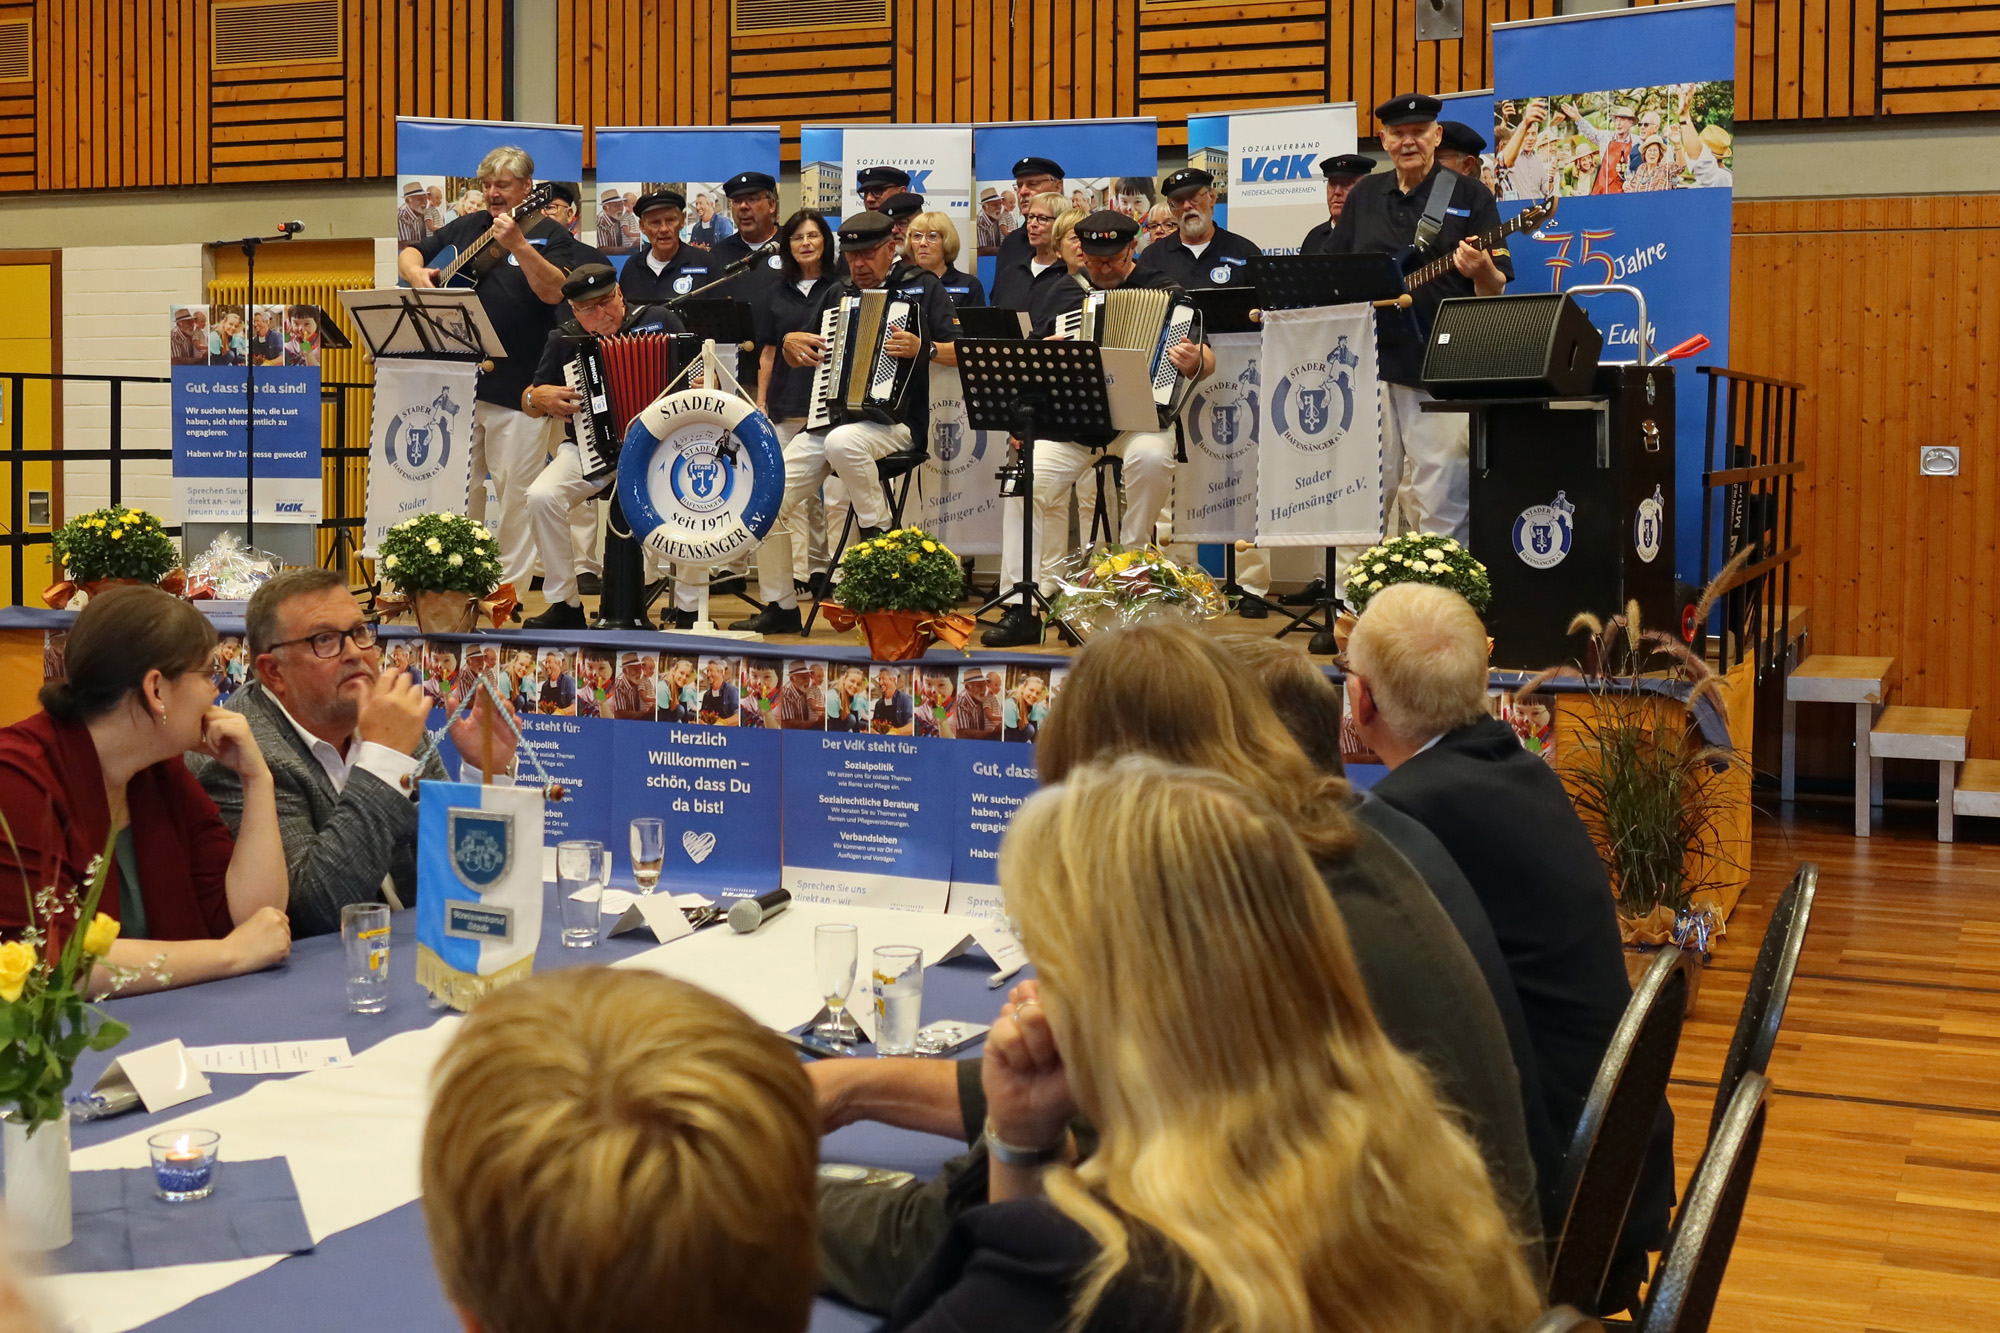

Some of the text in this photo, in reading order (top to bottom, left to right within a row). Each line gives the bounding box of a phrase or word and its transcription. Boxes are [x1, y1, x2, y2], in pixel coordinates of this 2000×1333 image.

[1242, 142, 1320, 152] SOZIALVERBAND
[1242, 154, 1318, 182] VdK
[1262, 248, 1302, 256] MEINS
[1532, 227, 1667, 297] 75 Jahre
[588, 356, 599, 384] HOHNER
[1290, 362, 1326, 379] STADER
[186, 382, 306, 394] Gut, dass Se da sind!
[1205, 382, 1238, 395] STADER
[228, 408, 268, 416] Menshen,
[402, 405, 431, 418] STADER
[661, 396, 726, 420] STADER
[929, 400, 961, 413] STADER
[1284, 431, 1335, 452] HAFENSÄNGER
[274, 451, 307, 459] geweckt?
[684, 445, 717, 457] STADER
[1199, 442, 1245, 460] HAFENSÄNGER
[393, 462, 432, 481] HAFENSÄNGER
[924, 462, 966, 476] AFENSÄNGER
[1208, 475, 1241, 493] Stader
[1295, 469, 1332, 490] Stader
[188, 487, 223, 496] Sprechen
[929, 490, 962, 508] Stader
[1271, 476, 1367, 521] Hafensänger e.V.
[276, 503, 303, 512] VdK
[399, 497, 427, 513] Stader
[681, 497, 723, 510] HAFENSÄNGER
[977, 499, 995, 514] e.V.
[1186, 492, 1252, 521] Hafensänger
[1525, 508, 1551, 517] STADER
[671, 511, 732, 531] seit 1977
[652, 512, 766, 559] HAFENSÄNGER e.V.
[535, 721, 560, 732] steht
[563, 721, 580, 733] für:
[670, 730, 727, 746] Herzlich
[822, 739, 918, 754] Der VdK steht für:
[648, 751, 737, 770] Willkommen
[845, 760, 894, 772] Sozialpolitik
[973, 762, 1038, 779] Gut, dass
[550, 776, 583, 787] Beratung
[647, 774, 751, 793] schön, dass Du
[672, 798, 724, 814] da bist!
[819, 794, 919, 811] Sozialrechtliche Beratung
[972, 793, 988, 803] Wir
[990, 794, 1022, 805] suchen
[971, 807, 1016, 819] haben, sic
[840, 832, 898, 844] Verbandsleben
[970, 848, 1000, 860] Haben
[797, 880, 835, 891] Sprechen
[837, 884, 849, 892] Sie
[795, 893, 818, 903] direkt
[839, 897, 851, 905] wir
